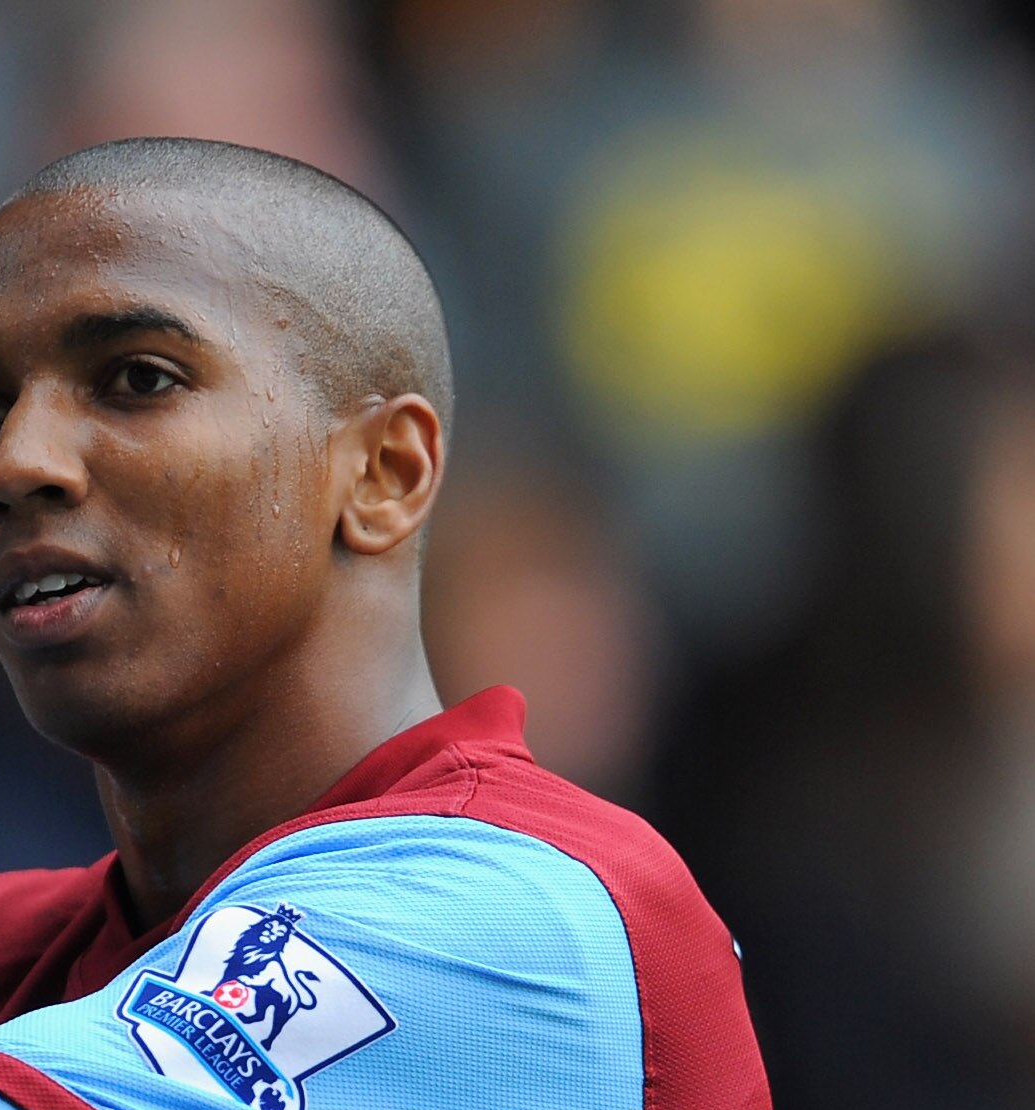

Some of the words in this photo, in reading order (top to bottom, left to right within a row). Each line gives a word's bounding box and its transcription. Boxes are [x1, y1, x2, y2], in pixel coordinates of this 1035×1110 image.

[136, 1003, 197, 1041] PREMIER
[194, 1033, 247, 1091] LEAGUE
[148, 989, 262, 1079] BARCLAYS
